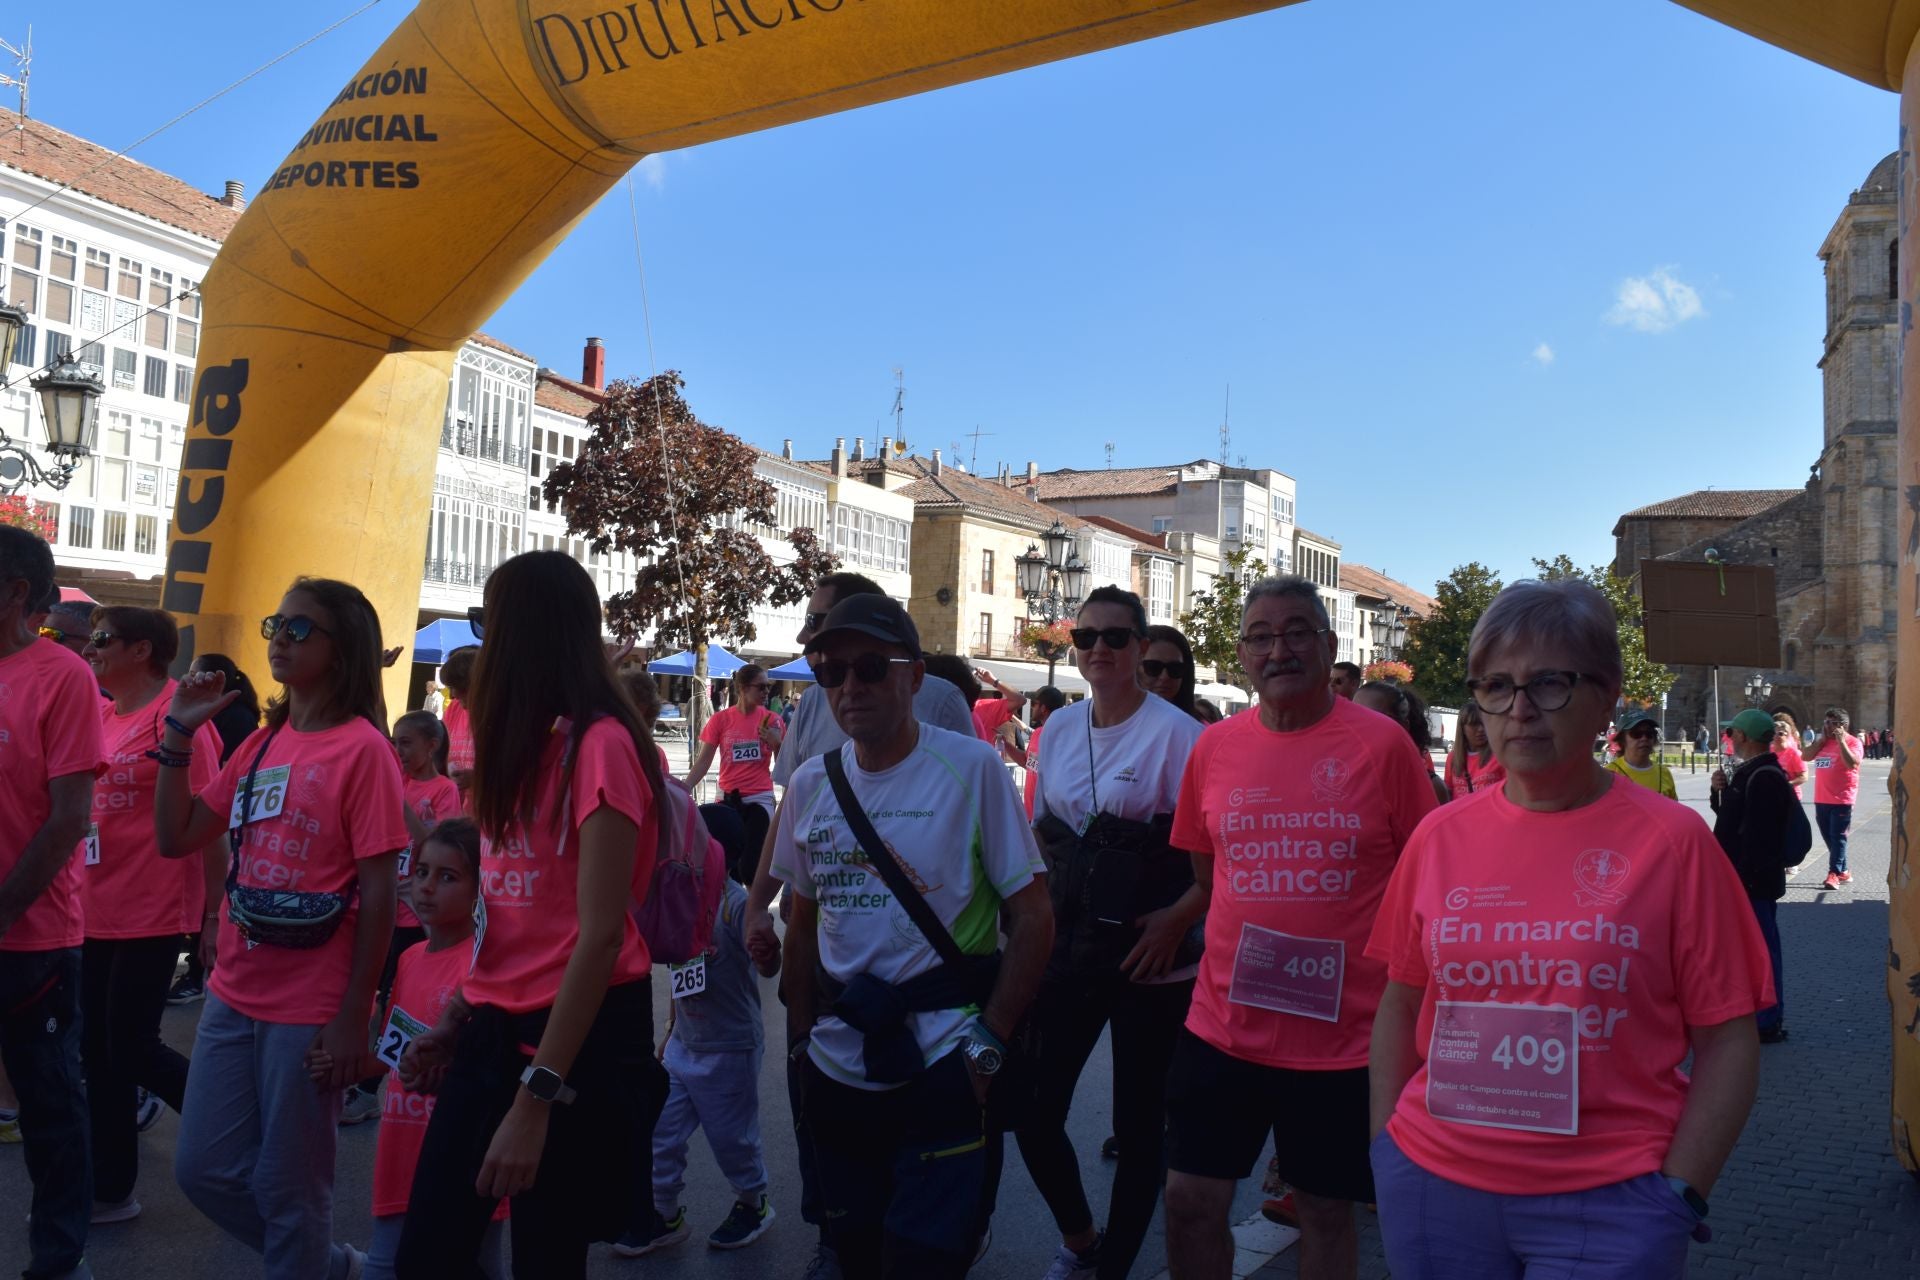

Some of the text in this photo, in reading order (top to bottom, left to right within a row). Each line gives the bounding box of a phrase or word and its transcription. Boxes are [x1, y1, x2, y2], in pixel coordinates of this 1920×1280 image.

[292, 114, 438, 153] OVINCIAL
[734, 748, 759, 760] 240
[895, 809, 934, 820] Campoo
[1227, 807, 1361, 832] En marcha
[807, 827, 830, 843] En
[283, 837, 311, 861] el
[1229, 835, 1357, 861] contra el
[812, 869, 866, 887] contra
[1232, 861, 1357, 894] cáncer
[829, 890, 892, 908] cáncer
[1429, 918, 1440, 967] CAMPOO
[1440, 913, 1640, 949] En marcha
[674, 965, 704, 994] 265
[1283, 955, 1336, 980] 408
[1442, 951, 1630, 992] contra el
[1440, 1039, 1468, 1048] contra
[1451, 1030, 1480, 1039] marcha
[1491, 1034, 1567, 1075] 409
[1459, 1083, 1469, 1092] de
[1469, 1084, 1501, 1096] Campoo
[1502, 1087, 1529, 1097] contra
[1529, 1089, 1538, 1098] el
[1465, 1103, 1475, 1112] de
[1476, 1104, 1508, 1115] octubre
[1508, 1107, 1520, 1116] de
[1520, 1109, 1542, 1119] 2025
